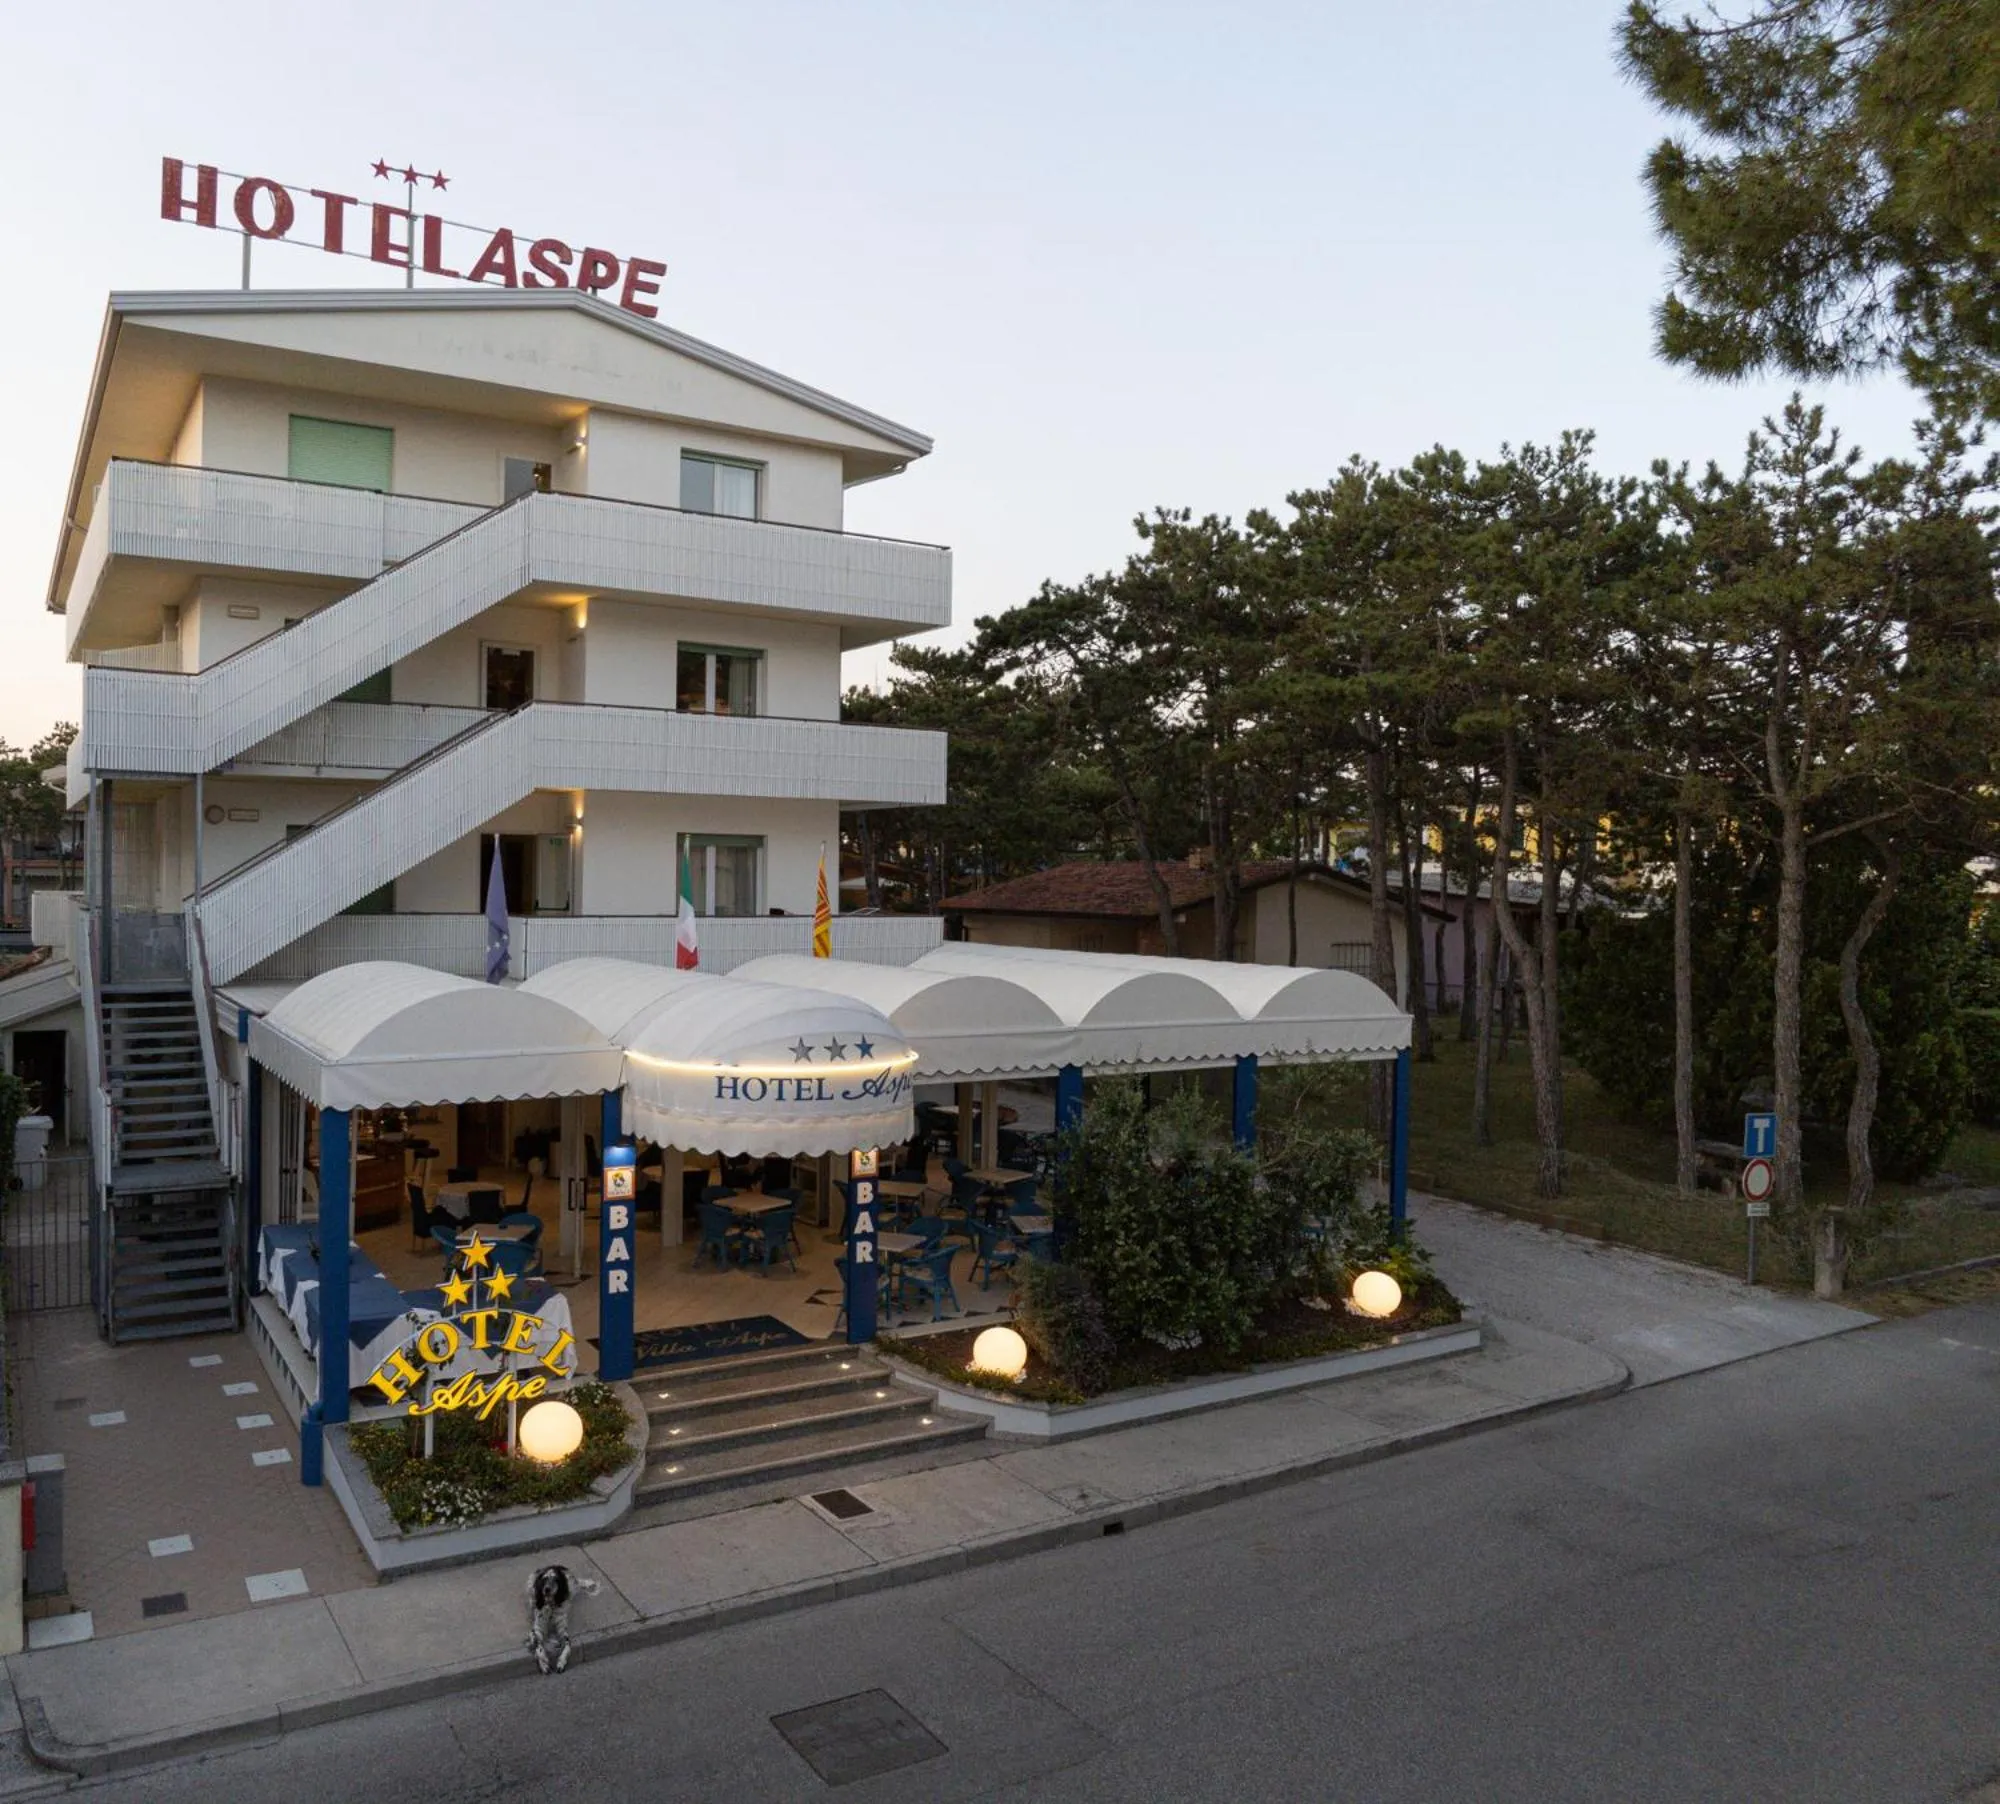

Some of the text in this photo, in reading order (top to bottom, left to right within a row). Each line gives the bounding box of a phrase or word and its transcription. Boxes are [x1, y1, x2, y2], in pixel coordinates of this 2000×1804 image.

[161, 157, 667, 318] HOTEL ASPE
[715, 1075, 834, 1102] HOTEL
[606, 1204, 631, 1294] BAR
[853, 1181, 874, 1264] BAR
[367, 1307, 577, 1407] HOTEL
[408, 1368, 547, 1421] Aspe
